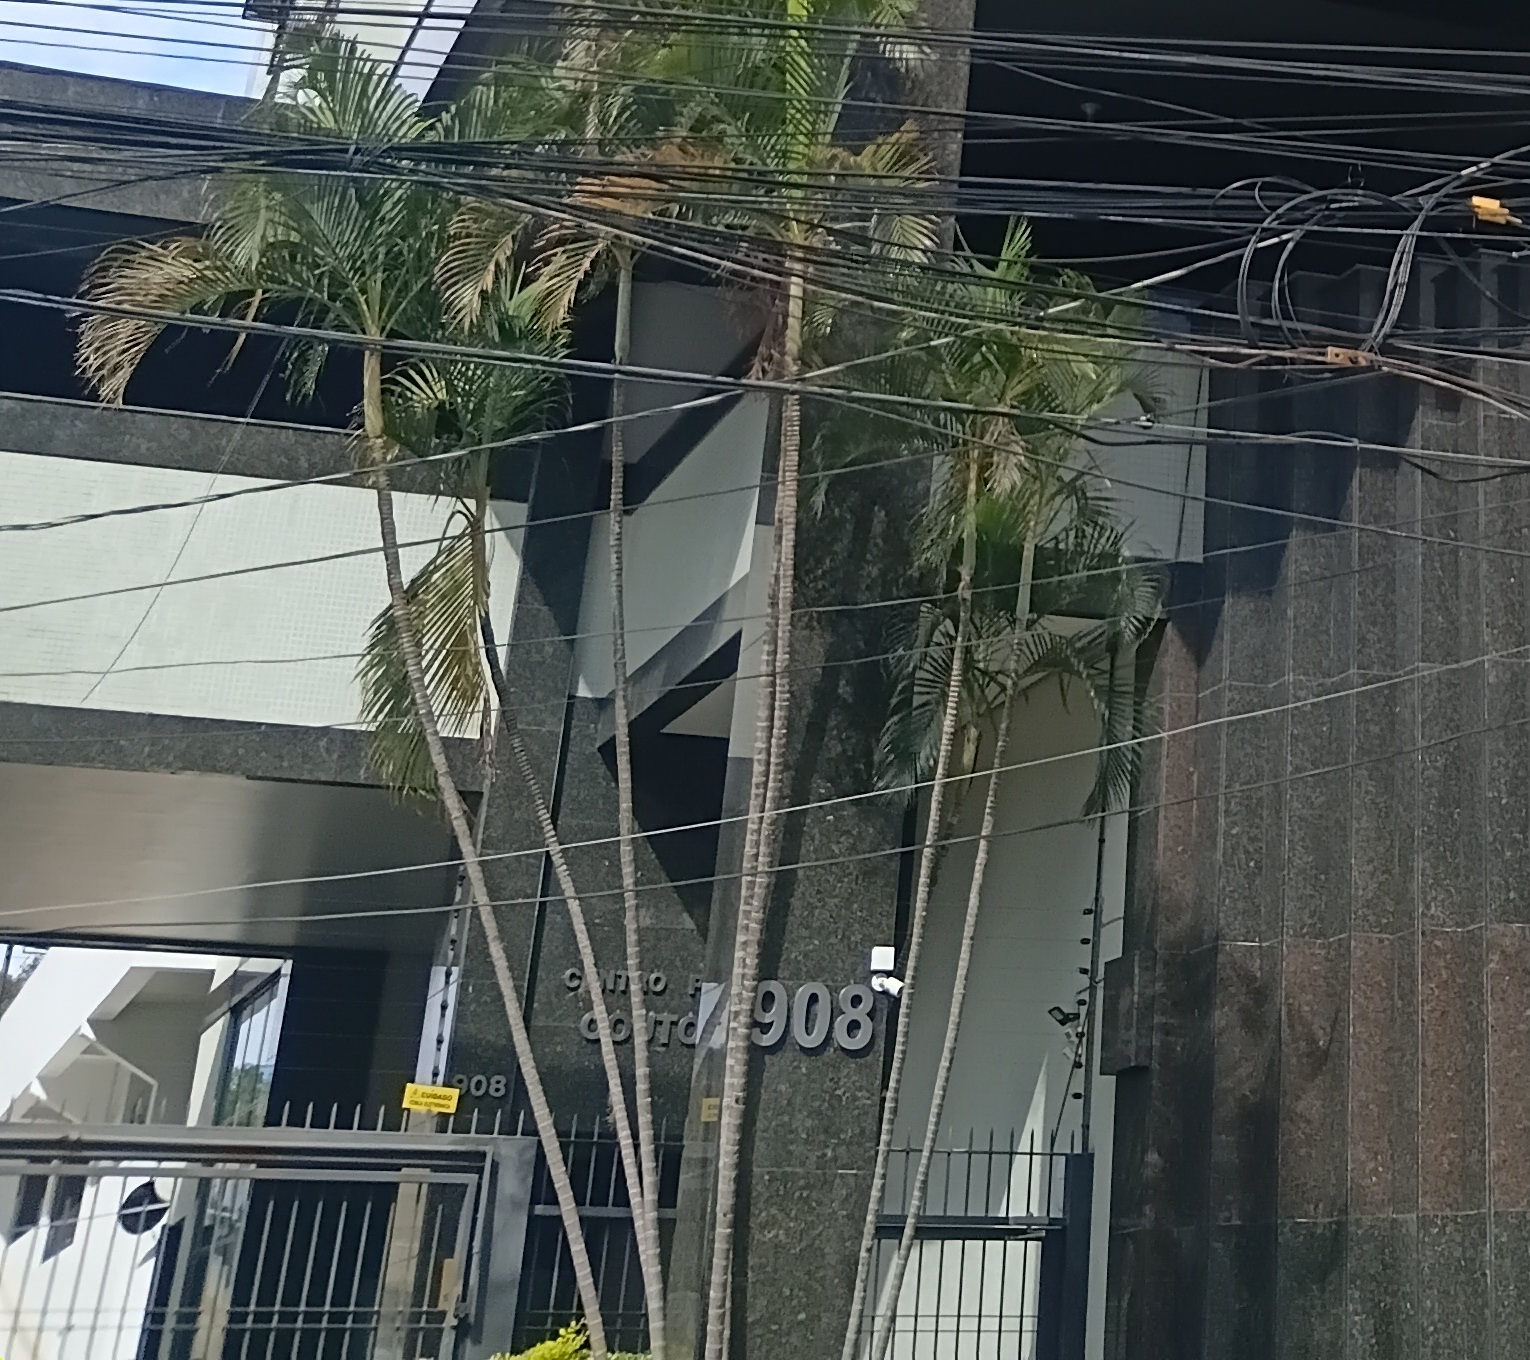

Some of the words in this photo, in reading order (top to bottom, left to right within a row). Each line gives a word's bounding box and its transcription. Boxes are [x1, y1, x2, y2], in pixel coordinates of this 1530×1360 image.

[562, 966, 667, 993] CNTO
[750, 979, 874, 1050] 908
[452, 1073, 507, 1098] 908
